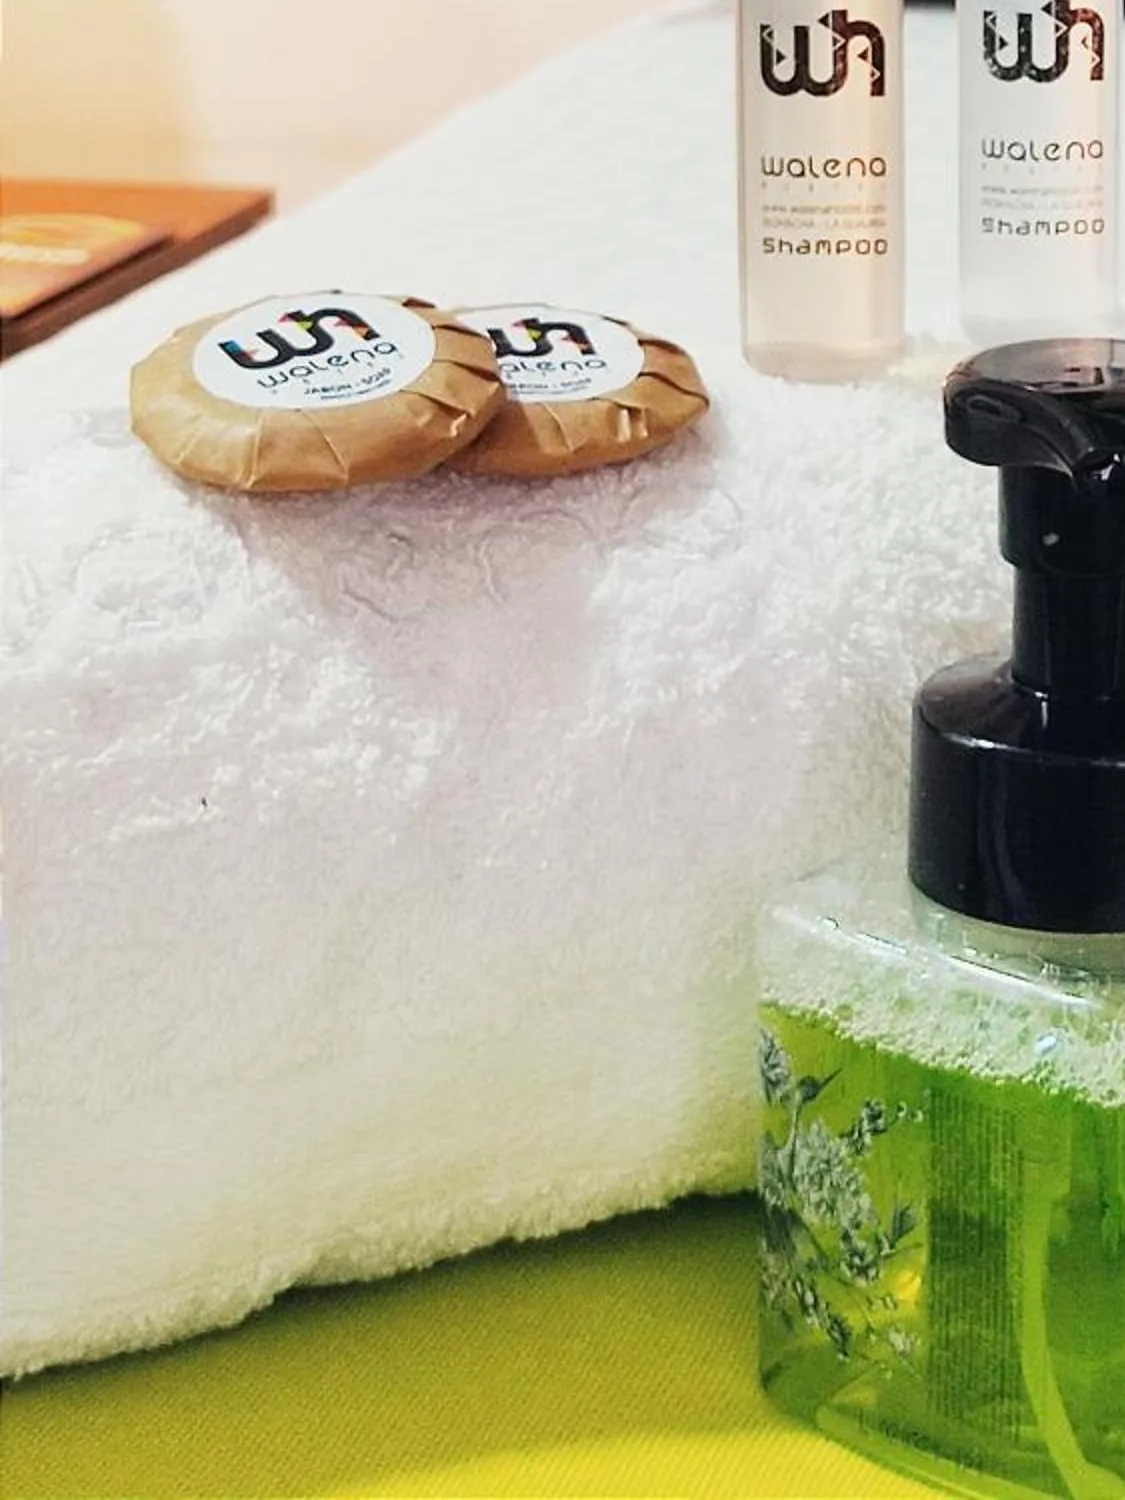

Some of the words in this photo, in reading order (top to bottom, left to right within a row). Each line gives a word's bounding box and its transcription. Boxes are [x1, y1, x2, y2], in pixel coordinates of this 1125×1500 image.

[981, 137, 1105, 162] walena
[760, 155, 888, 179] walena
[257, 341, 398, 388] walena
[499, 358, 608, 375] alena
